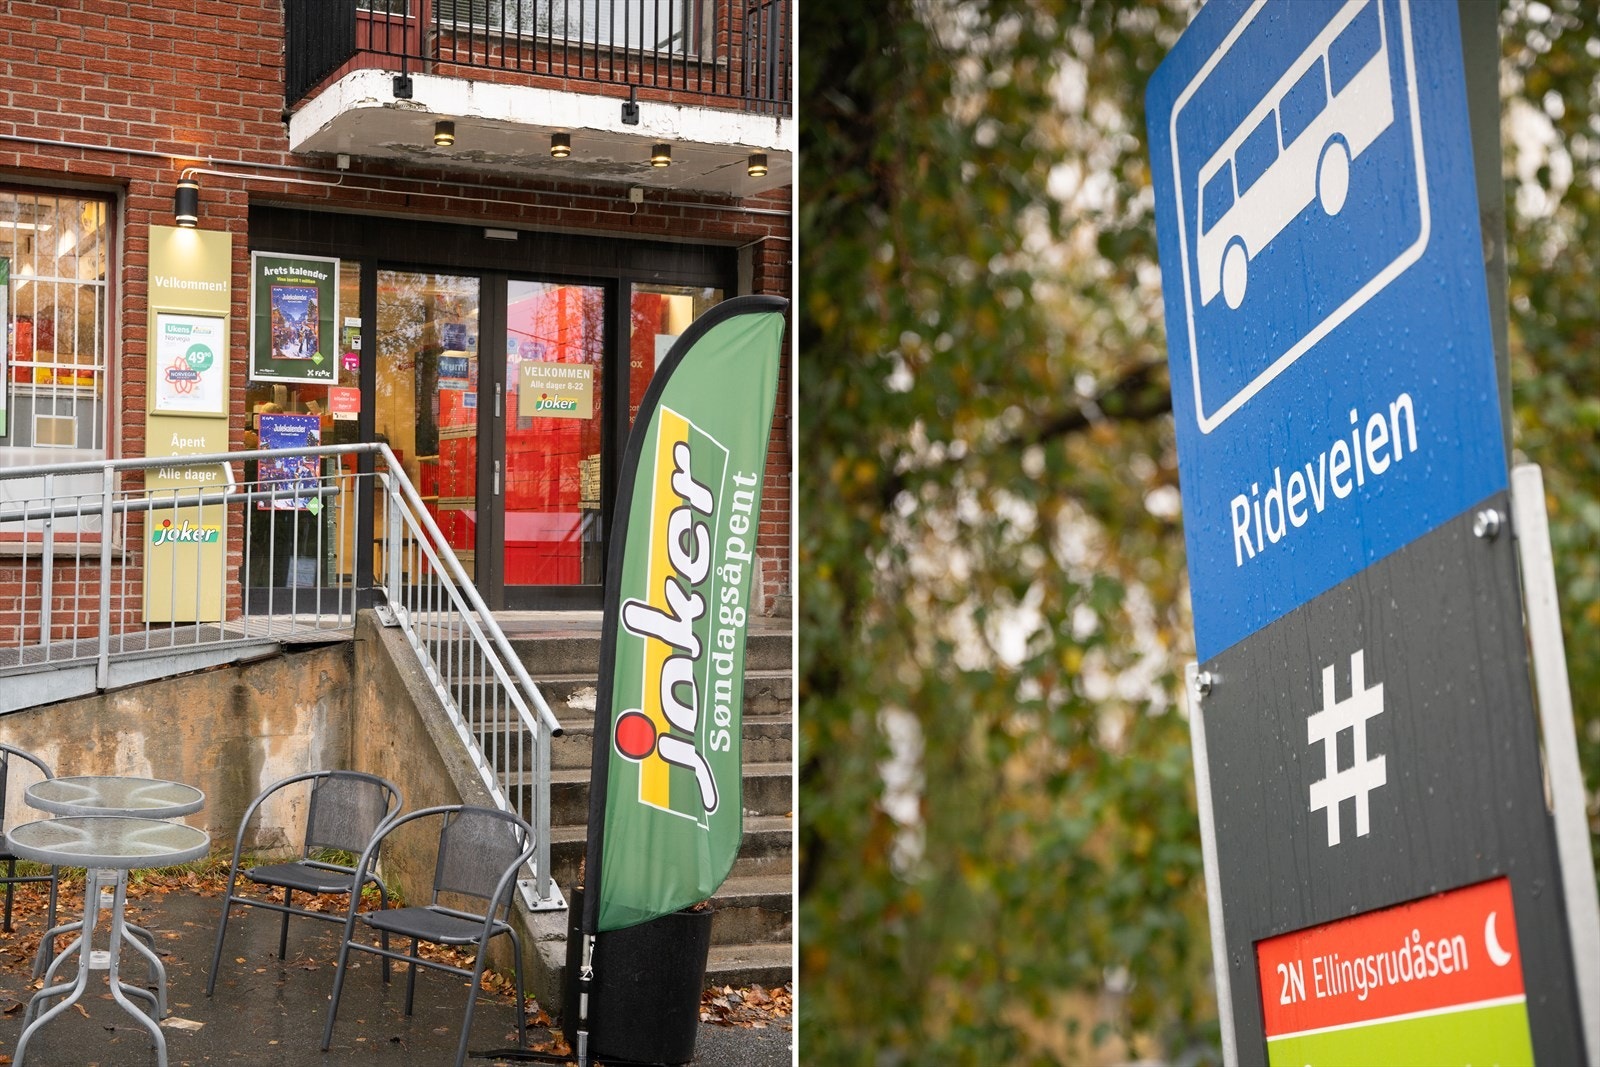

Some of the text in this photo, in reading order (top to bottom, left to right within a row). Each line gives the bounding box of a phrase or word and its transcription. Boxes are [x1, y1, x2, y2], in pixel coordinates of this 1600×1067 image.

[289, 266, 328, 281] kalender
[155, 275, 227, 293] Velkommen!
[167, 325, 190, 334] Ukens
[314, 369, 331, 378] FLAX
[440, 360, 468, 372] trumf
[524, 366, 590, 379] VELKOMMEN
[530, 380, 584, 391] Alle dager 8-22
[537, 393, 575, 412] joker
[273, 423, 306, 433] Julekalender
[170, 432, 206, 449] Åpent
[158, 468, 217, 483] Alle dager
[1230, 392, 1418, 567] Rideveien
[154, 519, 217, 545] joker
[710, 470, 758, 752] Søndagsåpent
[615, 440, 718, 814] joker
[1276, 928, 1469, 1006] 2N Ellingsrudåsen
